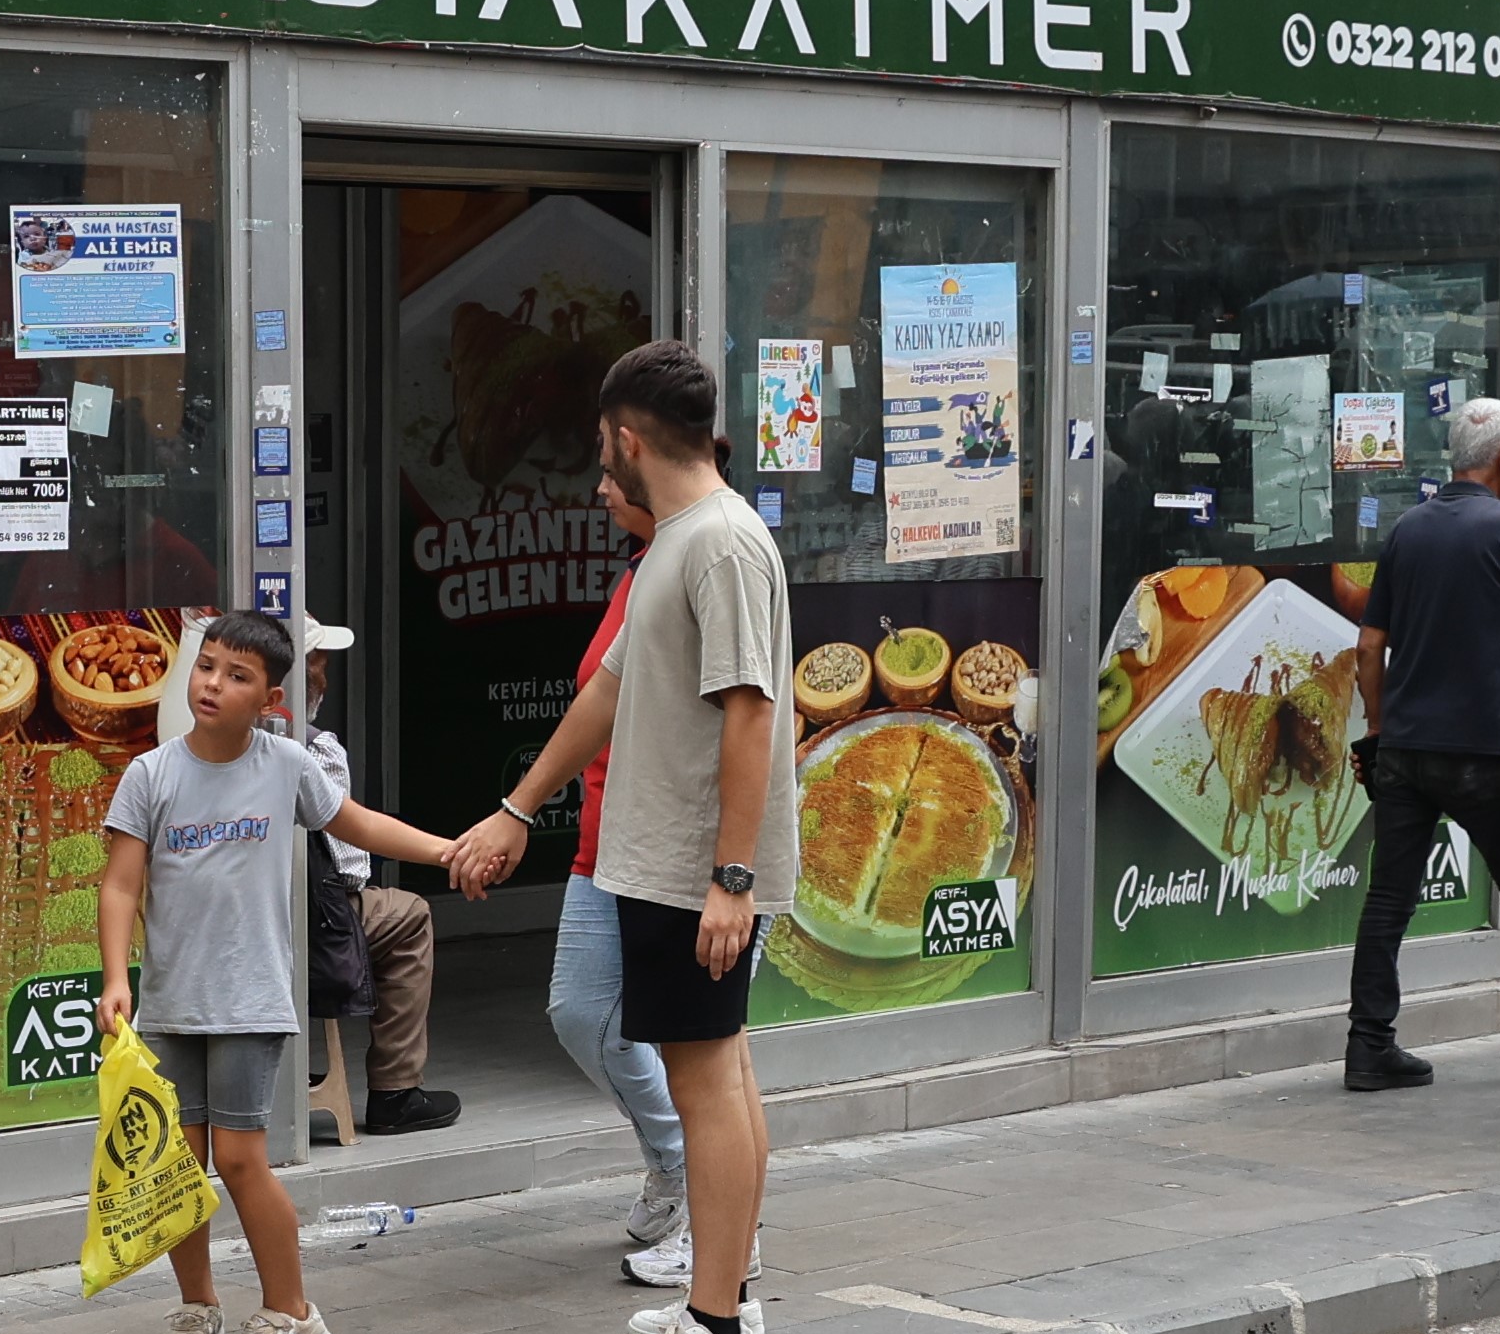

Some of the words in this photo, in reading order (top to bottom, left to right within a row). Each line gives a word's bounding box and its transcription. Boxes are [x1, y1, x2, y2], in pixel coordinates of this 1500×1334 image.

[1327, 20, 1413, 68] 0322
[1421, 30, 1476, 75] 212
[82, 222, 111, 234] SMA
[116, 222, 173, 234] HASTASI
[85, 238, 118, 255] ALİ
[124, 237, 172, 254] EMİR
[103, 261, 155, 272] KİMDİR?
[895, 324, 933, 351] KADIN
[938, 323, 963, 348] YAZ
[968, 321, 1005, 347] KAMPI
[761, 343, 807, 364] DİRENİŞ
[52, 405, 64, 421] İŞ
[15, 487, 28, 495] Net
[14, 532, 33, 541] 996
[37, 532, 49, 541] 32
[902, 521, 940, 543] HALKEVCİ
[943, 521, 981, 539] KADINLAR
[259, 578, 286, 590] ADANA
[567, 560, 624, 603] LEZ
[488, 677, 537, 701] KEYFİ
[542, 679, 576, 698] ASY
[503, 702, 573, 721] KURULU
[532, 810, 580, 828] ATM
[1426, 842, 1459, 879] YA
[1215, 855, 1291, 915] Muska
[1297, 850, 1359, 902] Katmer
[1419, 881, 1455, 901] MER
[925, 898, 1010, 937] ASYA
[928, 932, 1004, 955] KATMER
[21, 1051, 103, 1081] KAT
[129, 1182, 147, 1199] AYT
[176, 1155, 197, 1176] ALES
